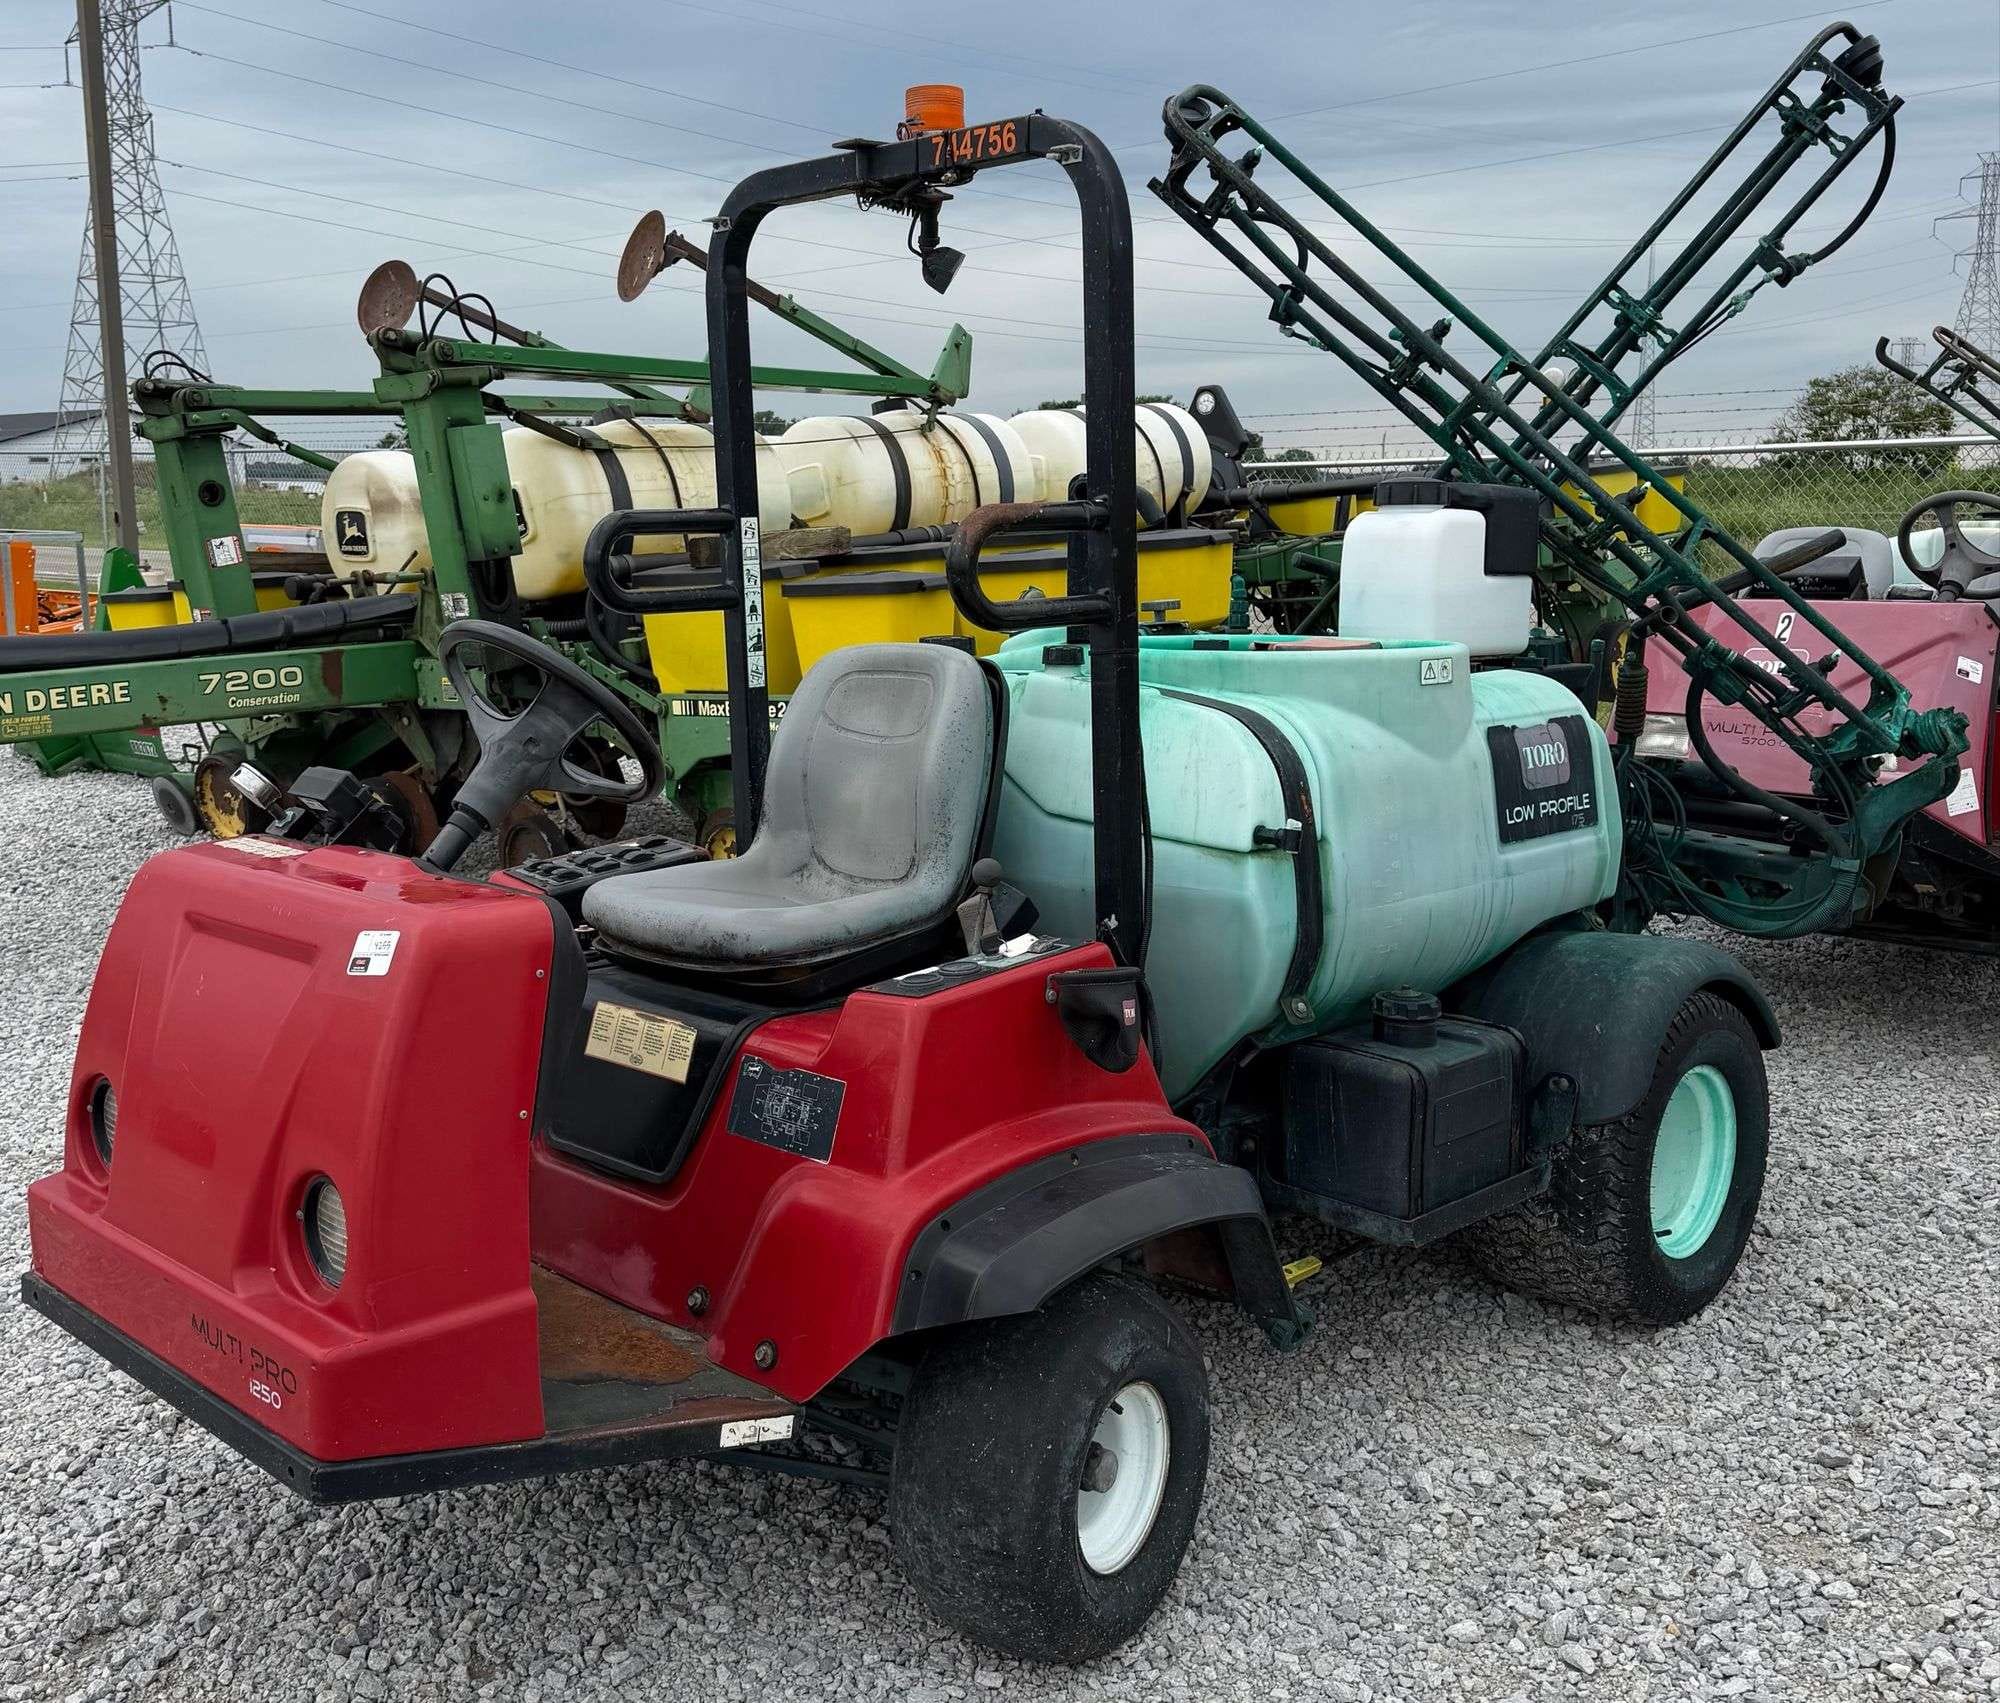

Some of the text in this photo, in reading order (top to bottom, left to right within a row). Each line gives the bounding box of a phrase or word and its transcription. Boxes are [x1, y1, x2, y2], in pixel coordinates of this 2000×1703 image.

[1776, 614, 1793, 641] 2
[199, 666, 303, 695] 7200
[25, 681, 131, 712] DEERE
[228, 692, 300, 708] Conservation
[1707, 720, 1756, 735] MULTI
[1522, 741, 1566, 769] TORO
[1506, 793, 1591, 825] LOW PROFILE
[191, 1313, 243, 1364] MULTI
[250, 1347, 297, 1395] PRO
[249, 1379, 281, 1410] 1250
